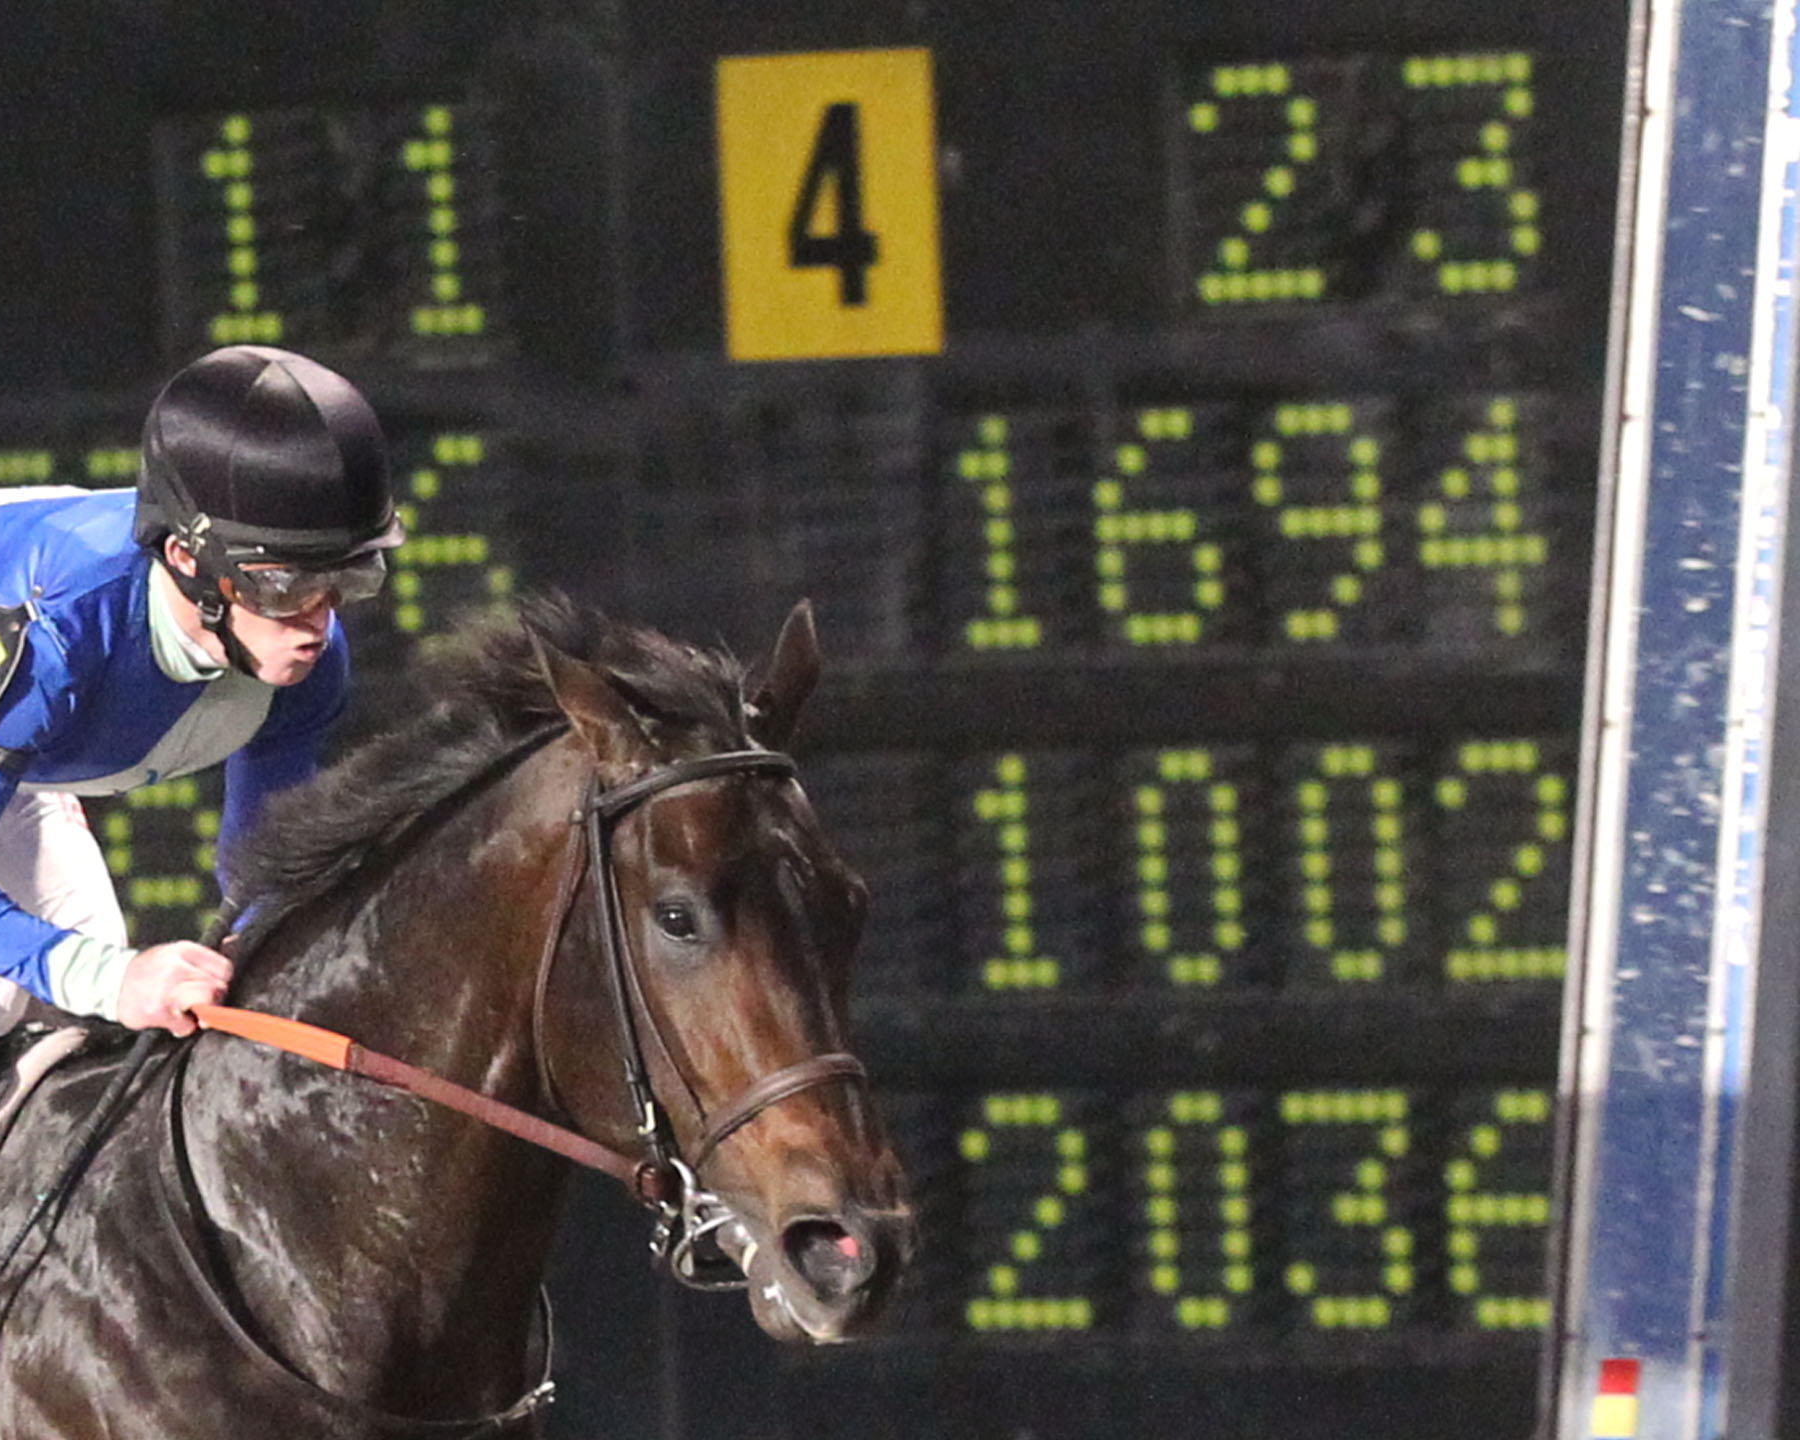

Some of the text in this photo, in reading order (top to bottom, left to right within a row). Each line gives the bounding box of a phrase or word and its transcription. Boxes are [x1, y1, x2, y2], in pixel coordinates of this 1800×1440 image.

[787, 102, 880, 309] 4
[1189, 52, 1542, 304] 23
[958, 401, 1546, 647] 1694
[974, 741, 1568, 986] 1002
